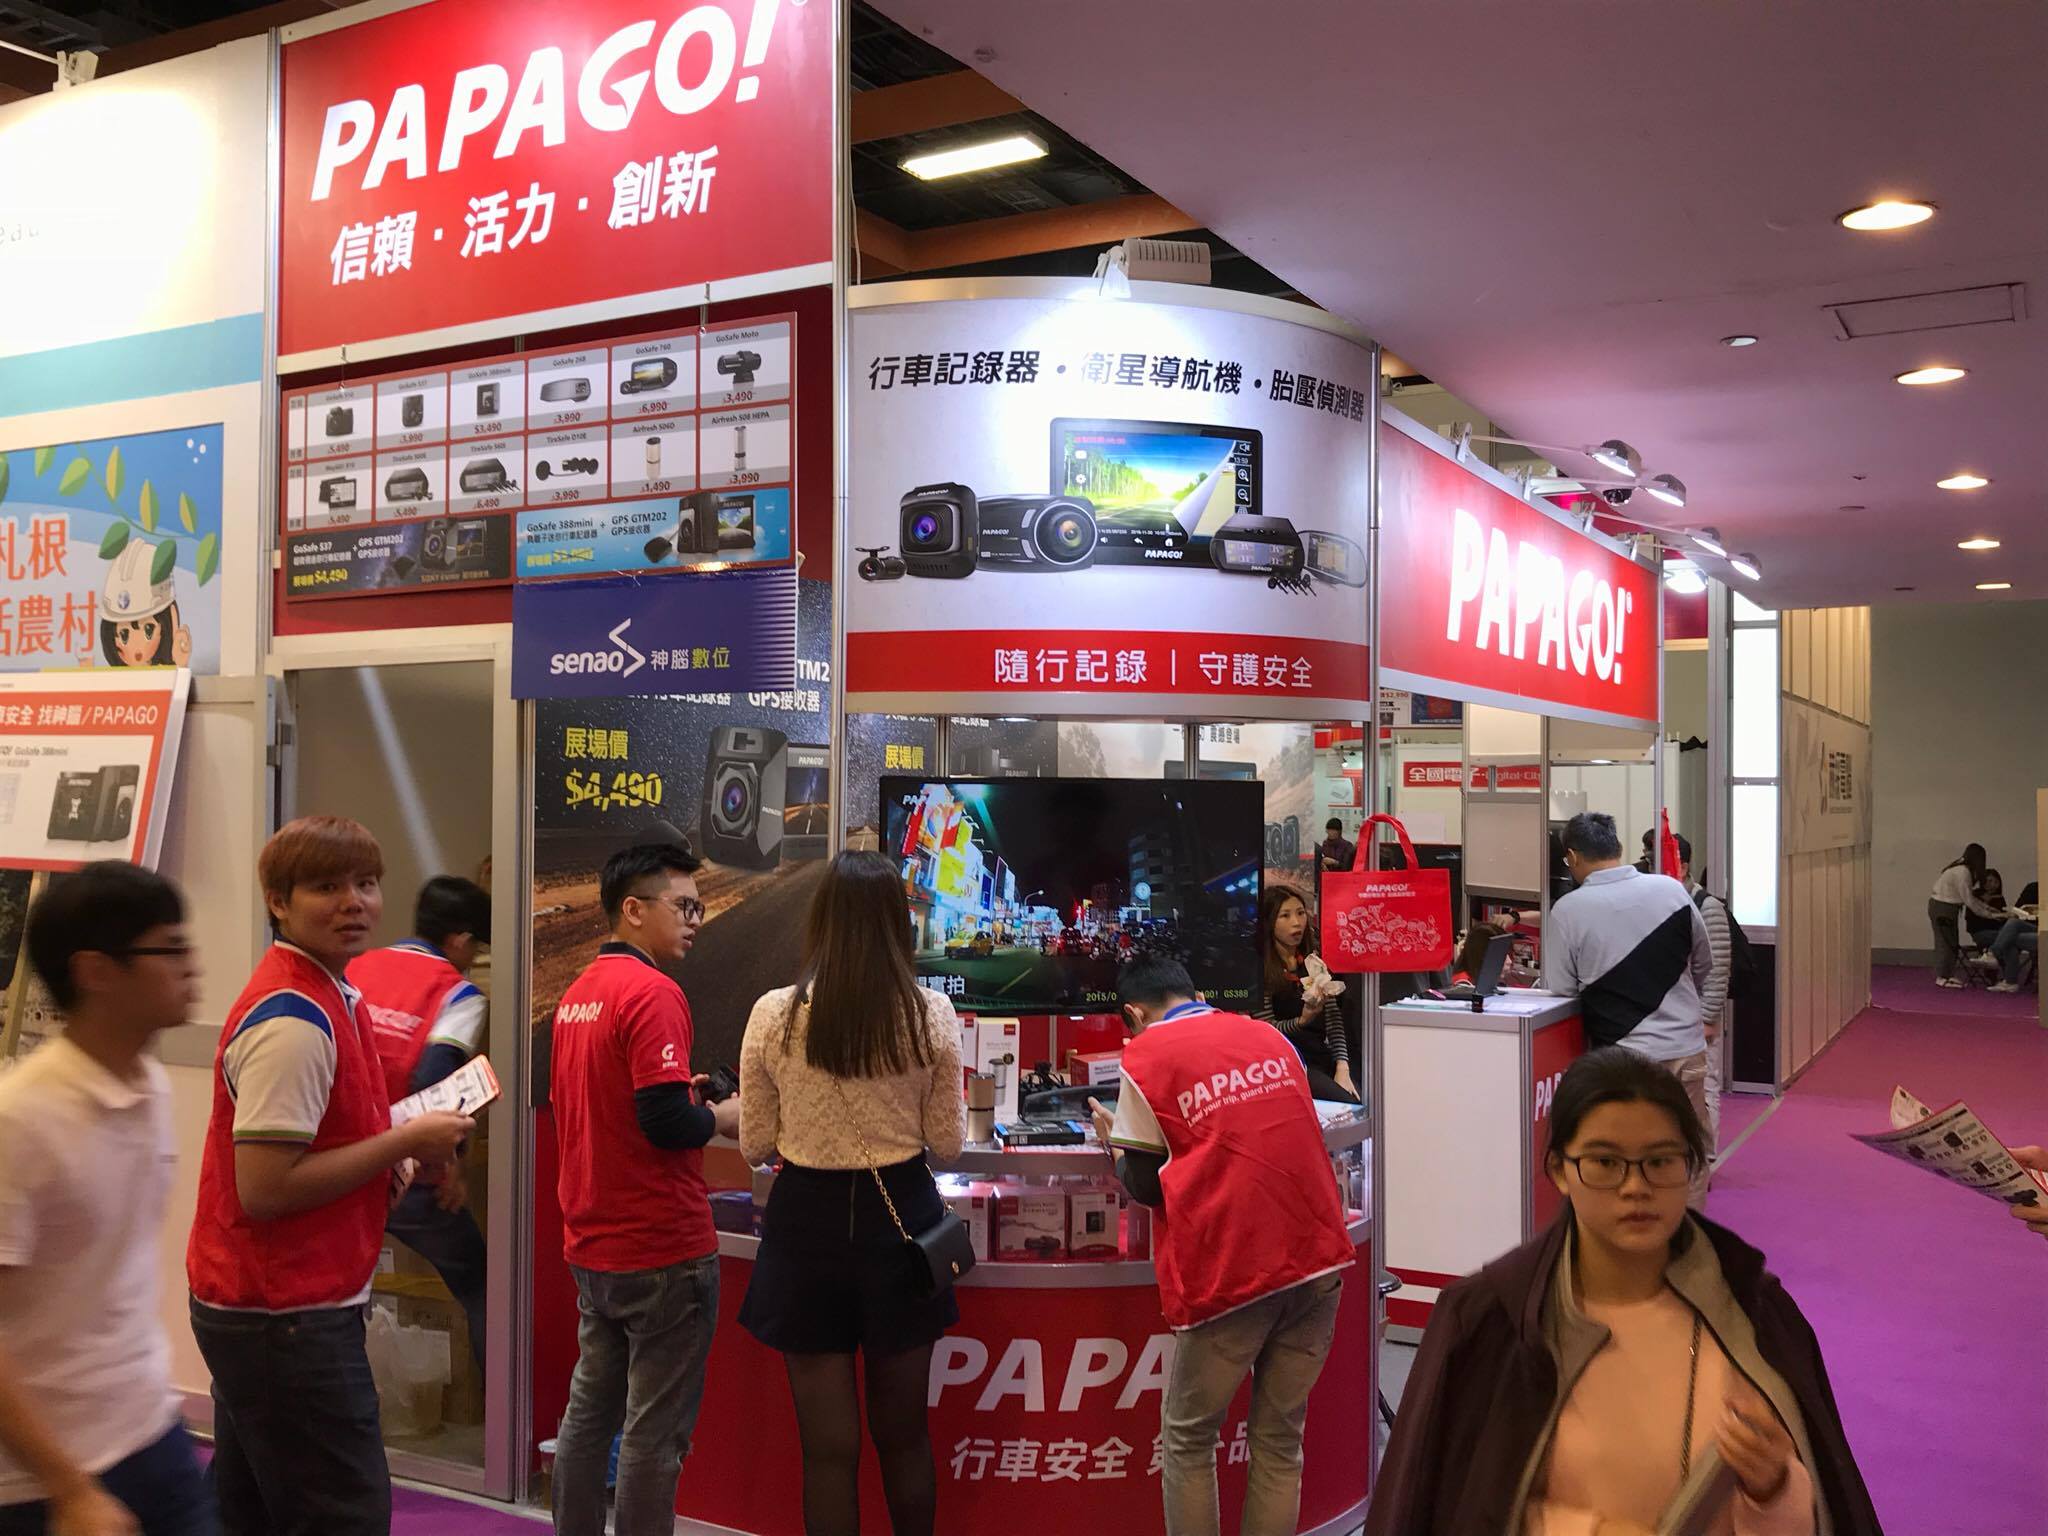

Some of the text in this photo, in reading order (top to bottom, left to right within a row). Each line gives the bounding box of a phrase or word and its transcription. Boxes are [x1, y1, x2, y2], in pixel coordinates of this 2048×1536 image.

[311, 0, 780, 201] PAPAGO!
[716, 330, 759, 343] GoSafe Moto
[867, 351, 1041, 390] 行車記錄器
[1269, 368, 1365, 423] 胎壓偵測器
[752, 411, 770, 420] HEPA
[527, 521, 557, 534] GoSafe
[559, 518, 593, 531] 388mini
[612, 514, 629, 525] GPS
[631, 511, 667, 524] GTM202
[1145, 549, 1183, 559] PAPAGO!
[1447, 508, 1626, 685] PAPAGO!
[550, 649, 624, 676] senao
[651, 647, 730, 671] 神腦數位
[994, 649, 1313, 690] 隨行記錄 守護安全
[564, 728, 629, 761] 展場價
[885, 744, 924, 770] 展場價
[1177, 1057, 1288, 1119] PAPAGO!
[1202, 1097, 1222, 1117] your
[1240, 1086, 1264, 1101] guard
[1264, 1080, 1282, 1095] your
[950, 1436, 1135, 1482] 行車安全
